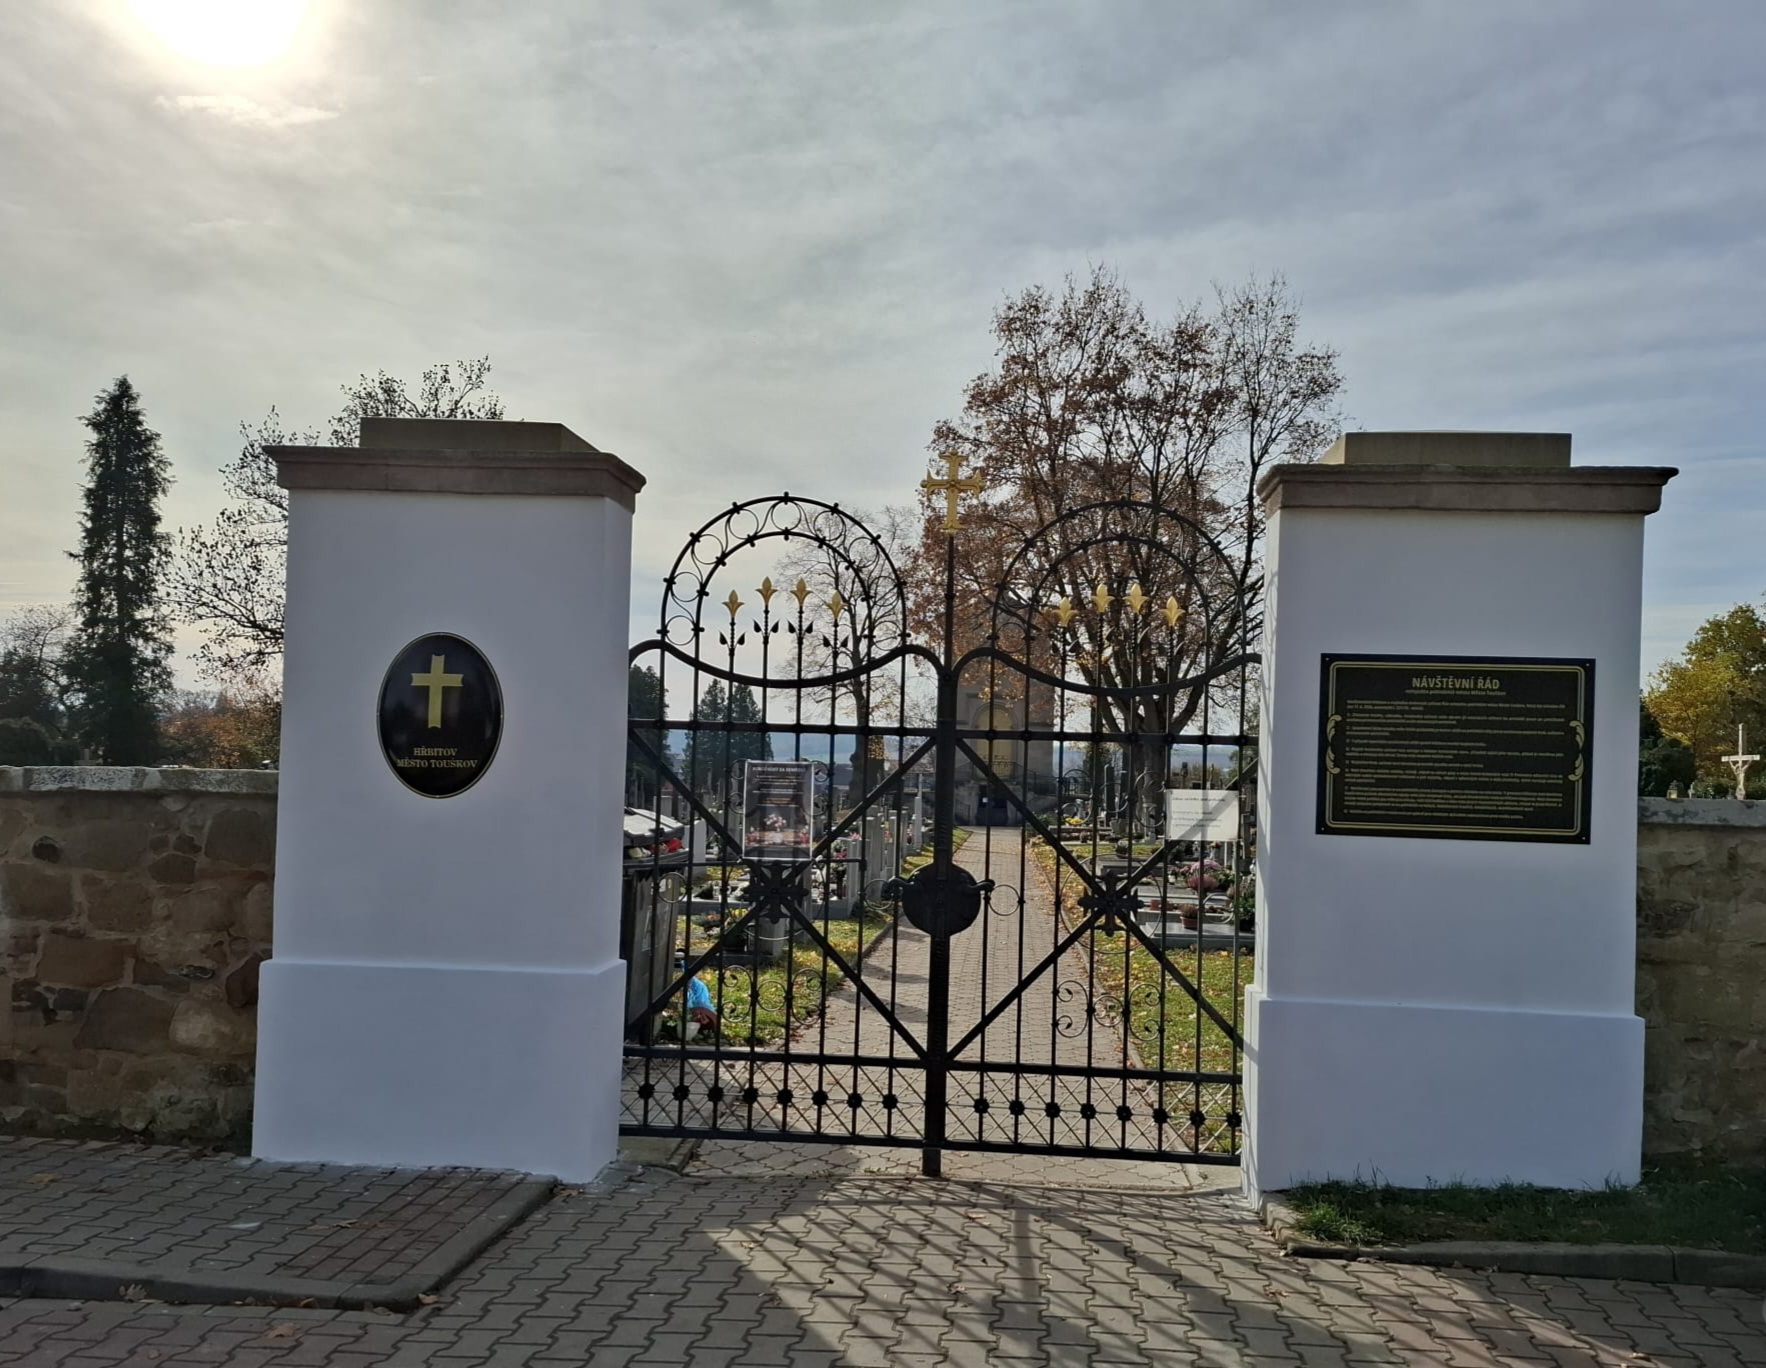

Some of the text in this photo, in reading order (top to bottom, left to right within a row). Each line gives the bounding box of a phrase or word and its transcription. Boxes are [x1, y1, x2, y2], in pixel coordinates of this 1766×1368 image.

[1412, 675, 1500, 689] NÁVŠTĚVNÍ ŘÁD
[413, 746, 458, 756] HŘBITOV
[397, 757, 478, 768] MĚSTO TOUŠKOV
